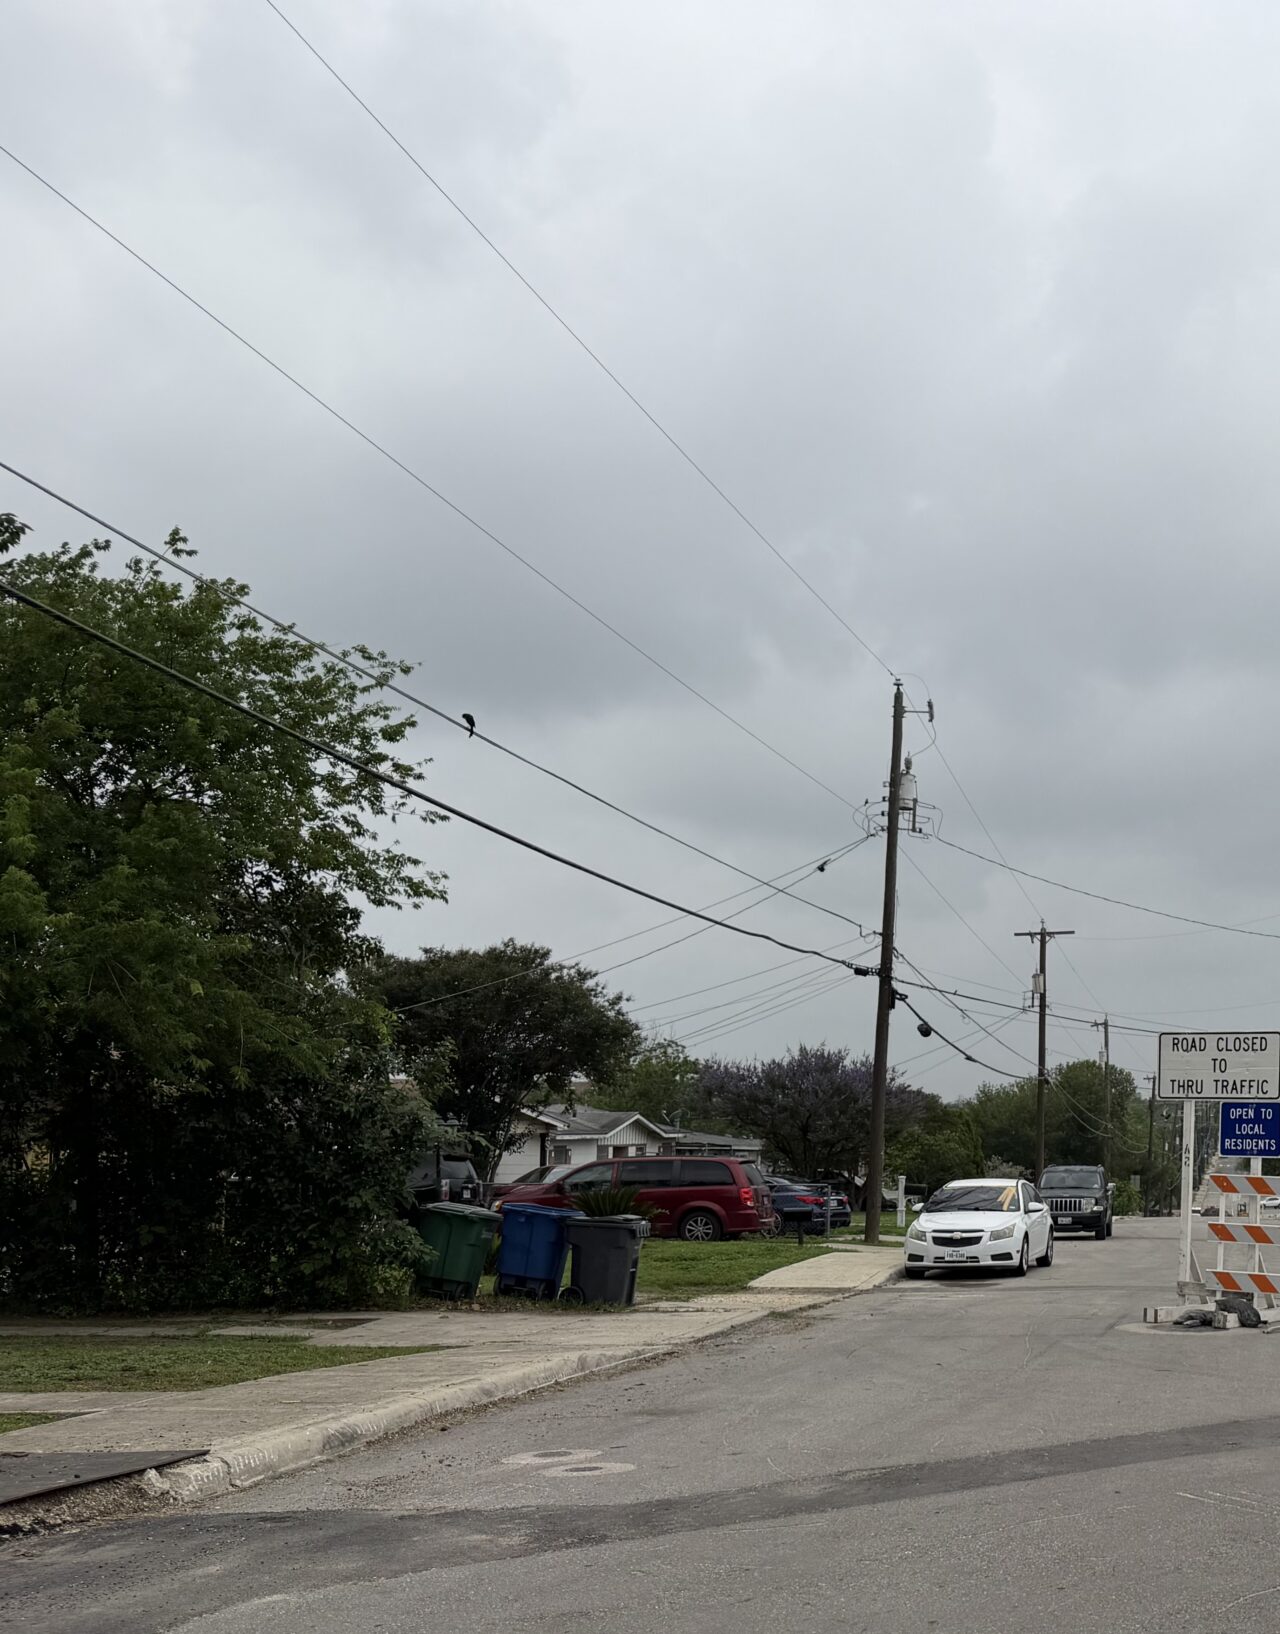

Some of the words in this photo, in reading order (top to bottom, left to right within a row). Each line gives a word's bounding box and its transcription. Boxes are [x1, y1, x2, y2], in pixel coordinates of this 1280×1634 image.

[1172, 1037, 1207, 1052] ROAD
[1216, 1037, 1268, 1052] CLOSED
[1211, 1058, 1227, 1073] TO
[1170, 1079, 1204, 1094] THRU
[1213, 1079, 1269, 1095] TRAFFIC
[1230, 1108, 1254, 1119] OPEN
[1260, 1108, 1273, 1119] TO
[1235, 1123, 1266, 1135] LOCAL
[1224, 1138, 1276, 1150] RESIDENTS
